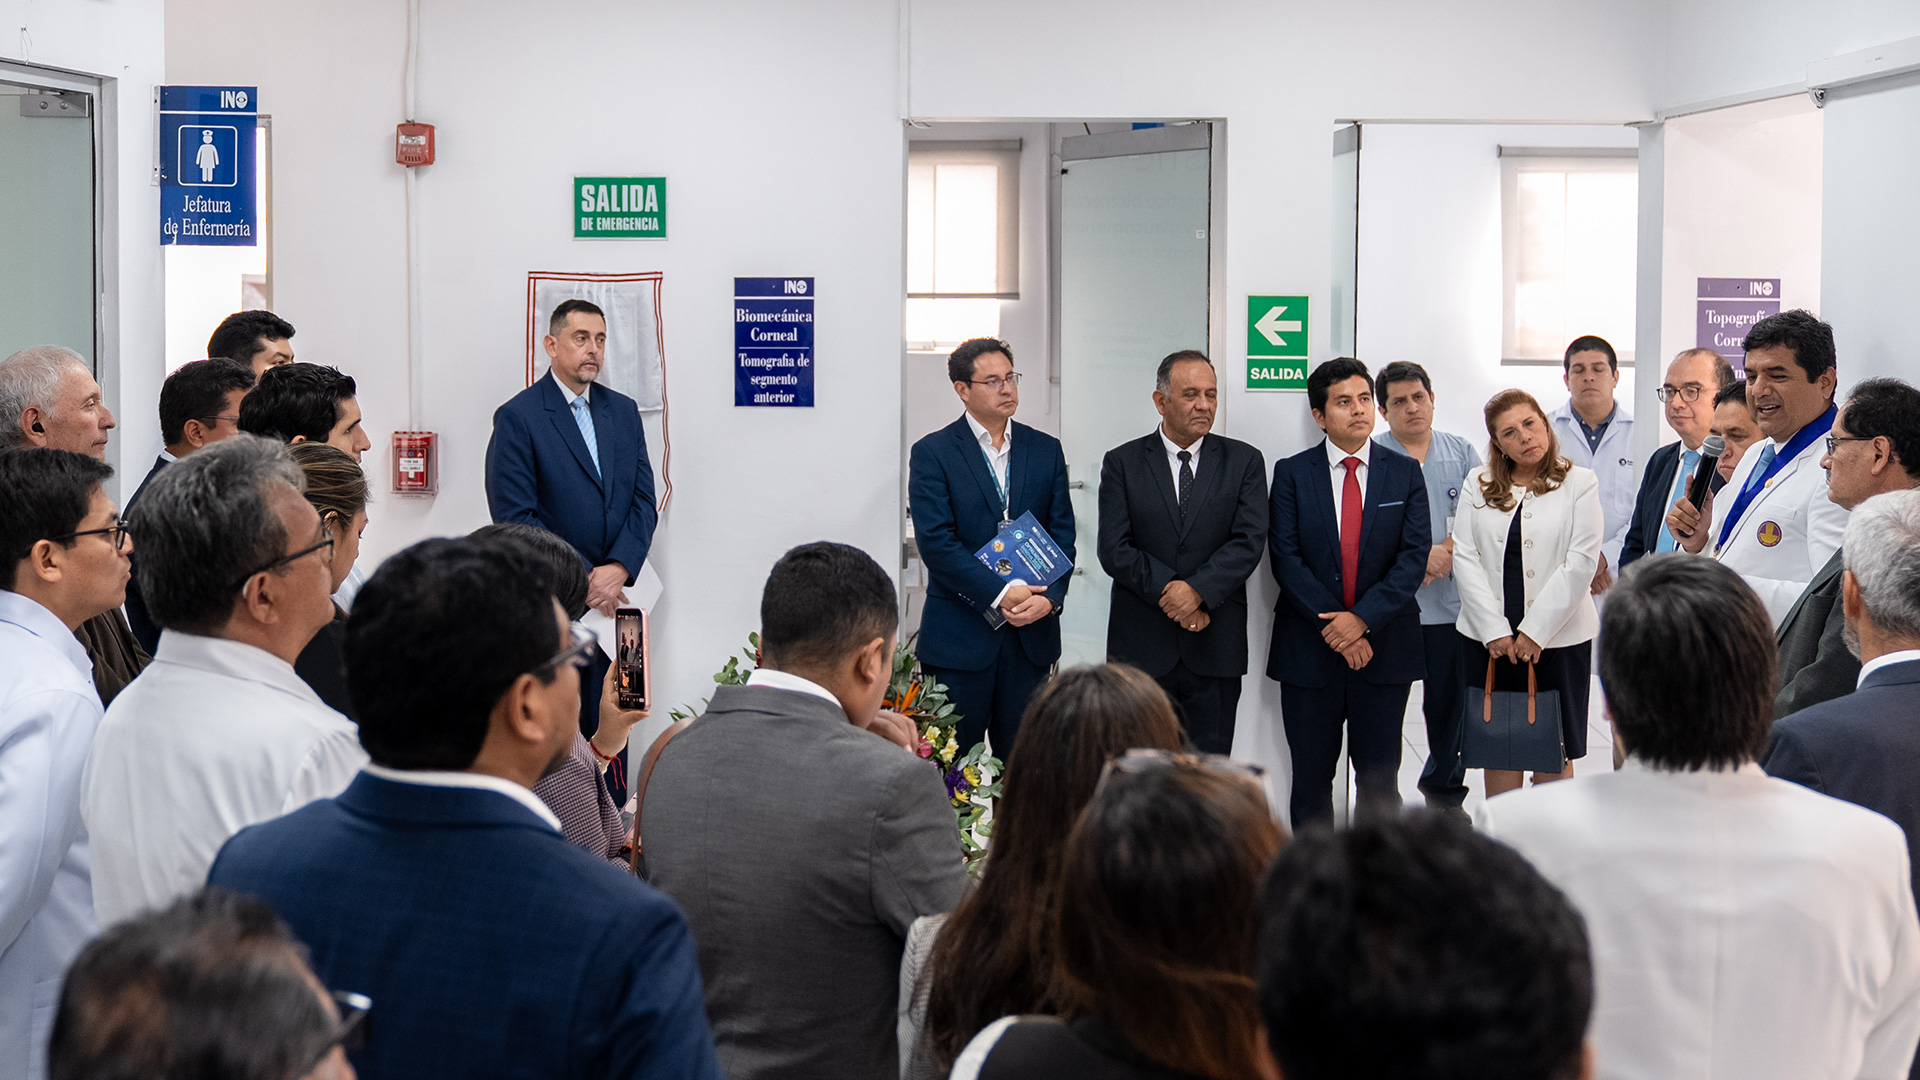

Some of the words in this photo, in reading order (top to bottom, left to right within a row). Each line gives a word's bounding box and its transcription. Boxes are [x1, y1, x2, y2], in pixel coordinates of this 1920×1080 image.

[220, 90, 248, 109] INO
[182, 195, 232, 214] Jefatura
[581, 184, 659, 212] SALIDA
[163, 217, 179, 236] de
[182, 217, 251, 237] Enfermería
[581, 217, 594, 231] DE
[596, 217, 660, 231] EMERGENCIA
[784, 280, 808, 294] INO
[1749, 281, 1774, 296] INO
[735, 307, 813, 323] Biomecánica
[750, 327, 798, 342] Corneal
[797, 352, 810, 367] de
[750, 373, 798, 389] segmento
[1250, 367, 1305, 380] SALIDA
[753, 390, 795, 403] anterior
